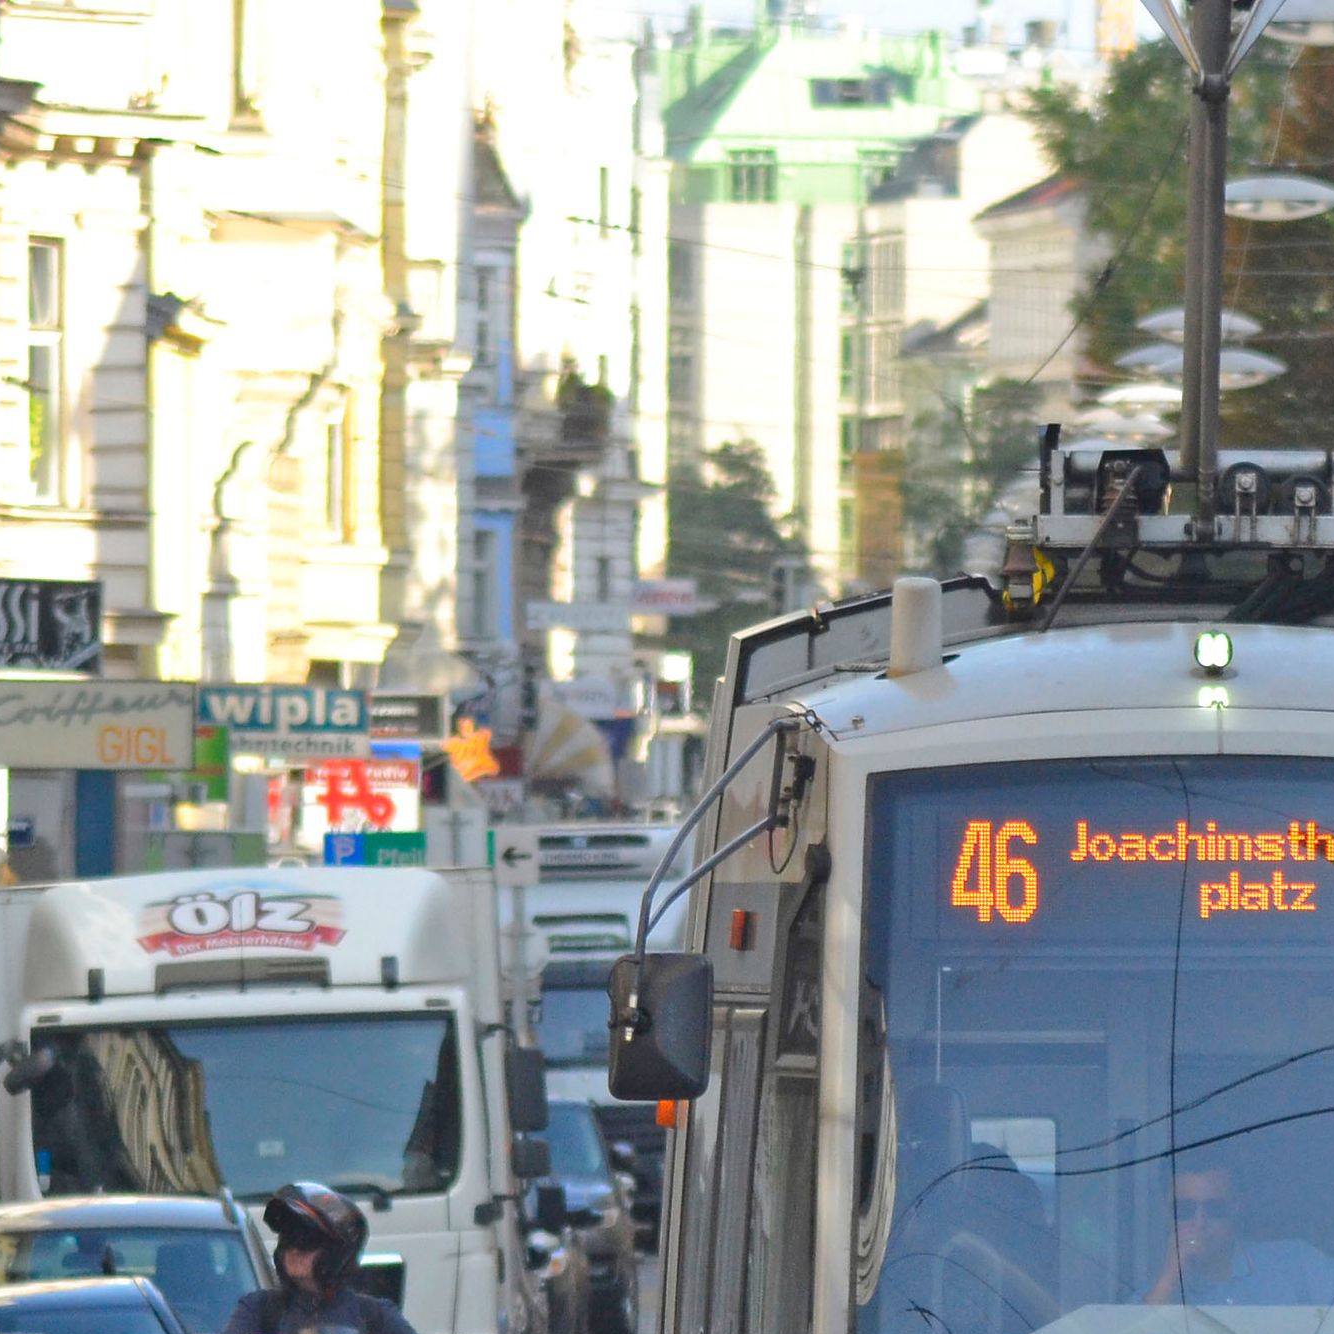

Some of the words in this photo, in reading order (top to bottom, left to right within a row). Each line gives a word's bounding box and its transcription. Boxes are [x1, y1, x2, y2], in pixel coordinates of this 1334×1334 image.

[208, 686, 359, 734] wipla
[97, 725, 175, 765] GIGL
[239, 737, 355, 753] hntechnik
[951, 821, 1038, 923] 46
[1199, 870, 1317, 919] platz
